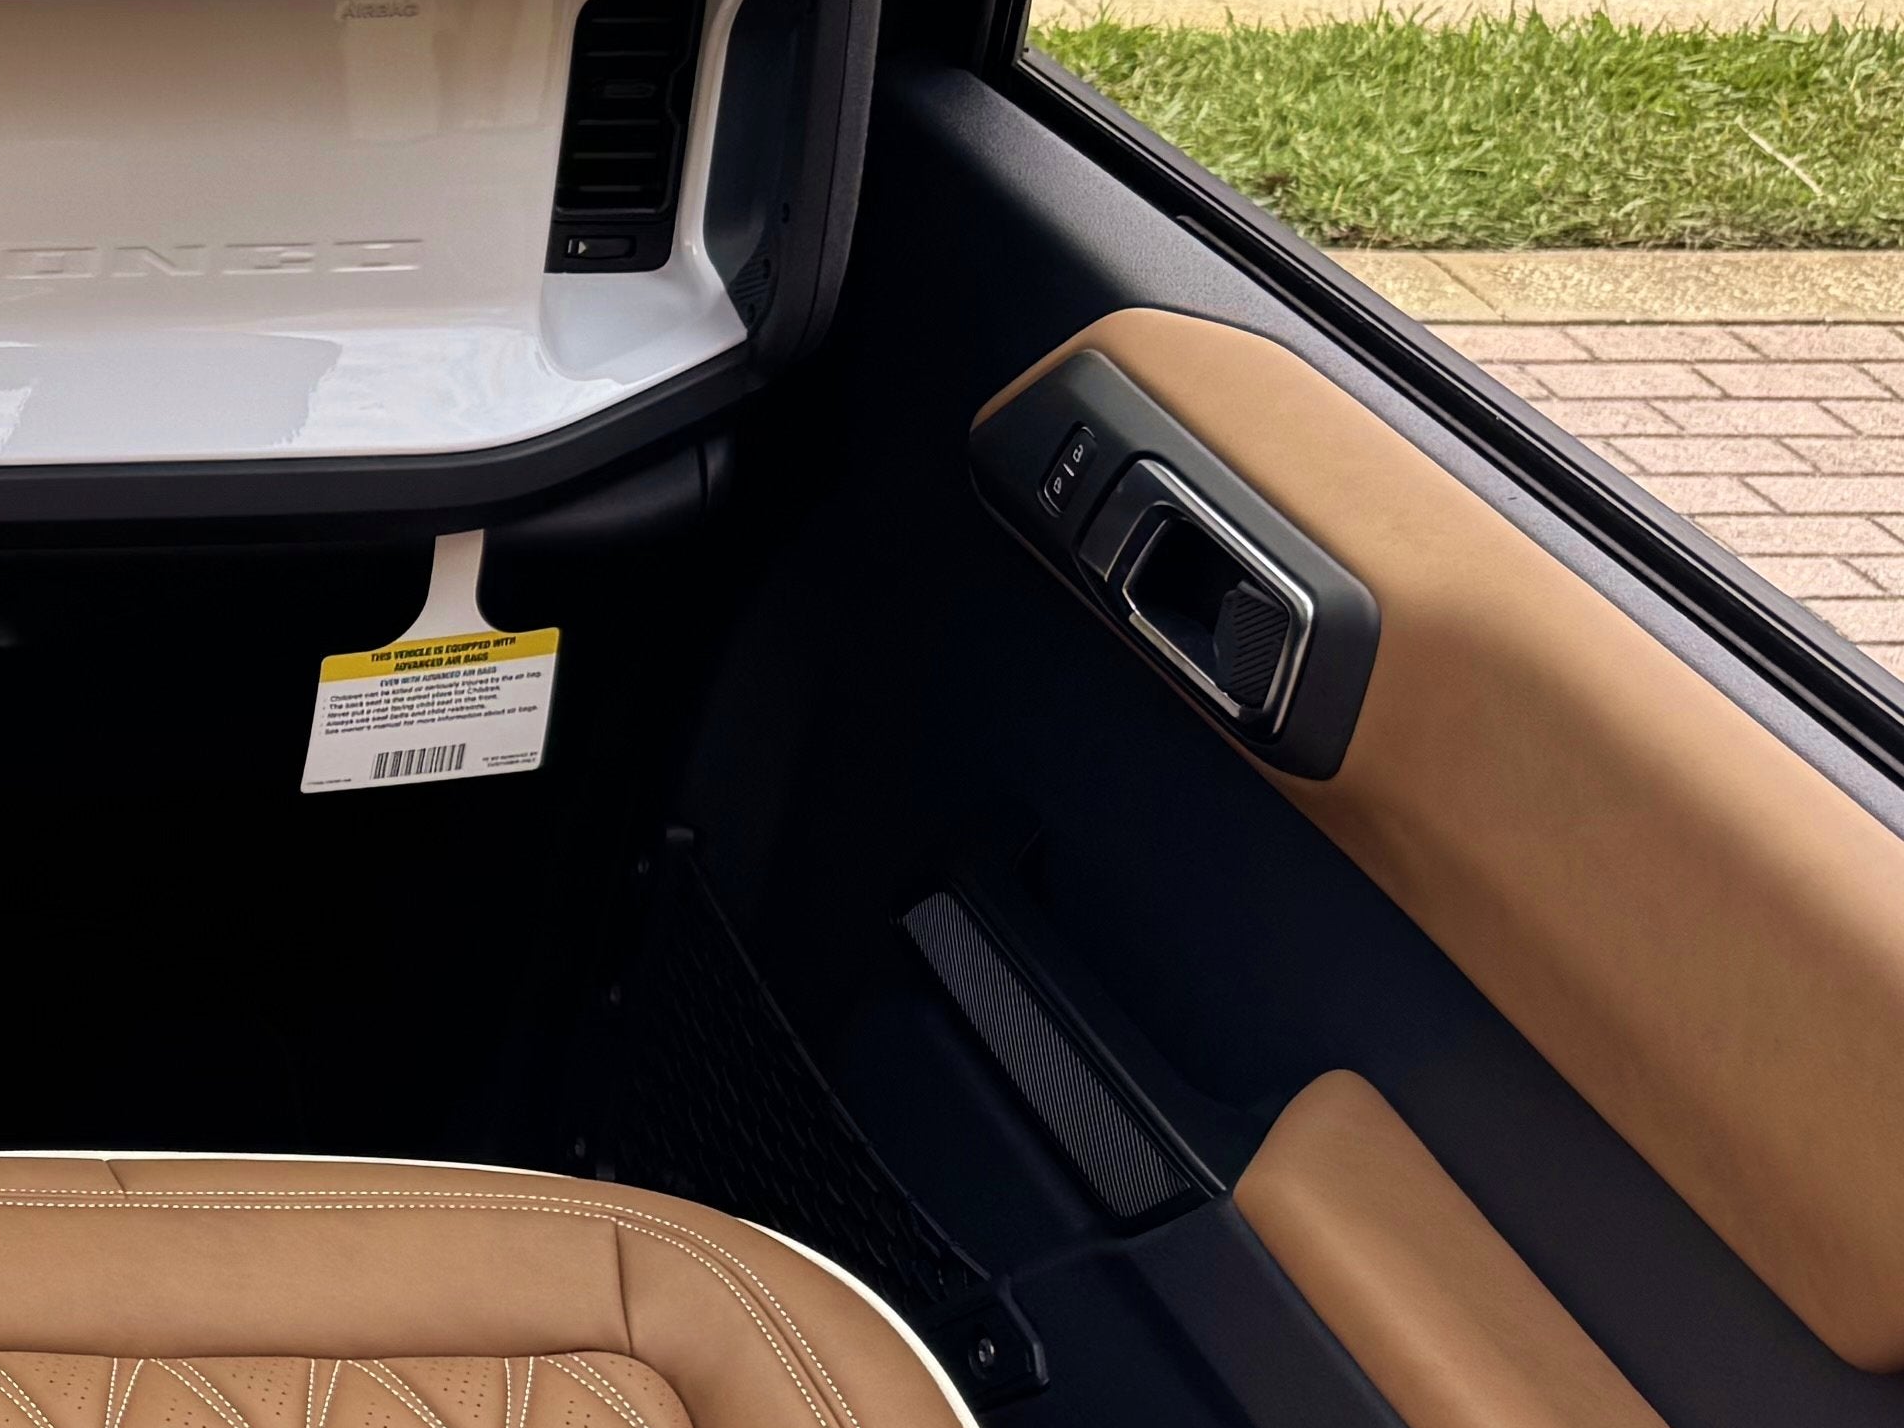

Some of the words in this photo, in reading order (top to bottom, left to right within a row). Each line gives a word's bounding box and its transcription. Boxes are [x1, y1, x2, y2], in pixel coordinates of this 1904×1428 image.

[371, 651, 392, 662] THIS
[393, 647, 432, 660] VEHICLE
[434, 645, 444, 656] IS
